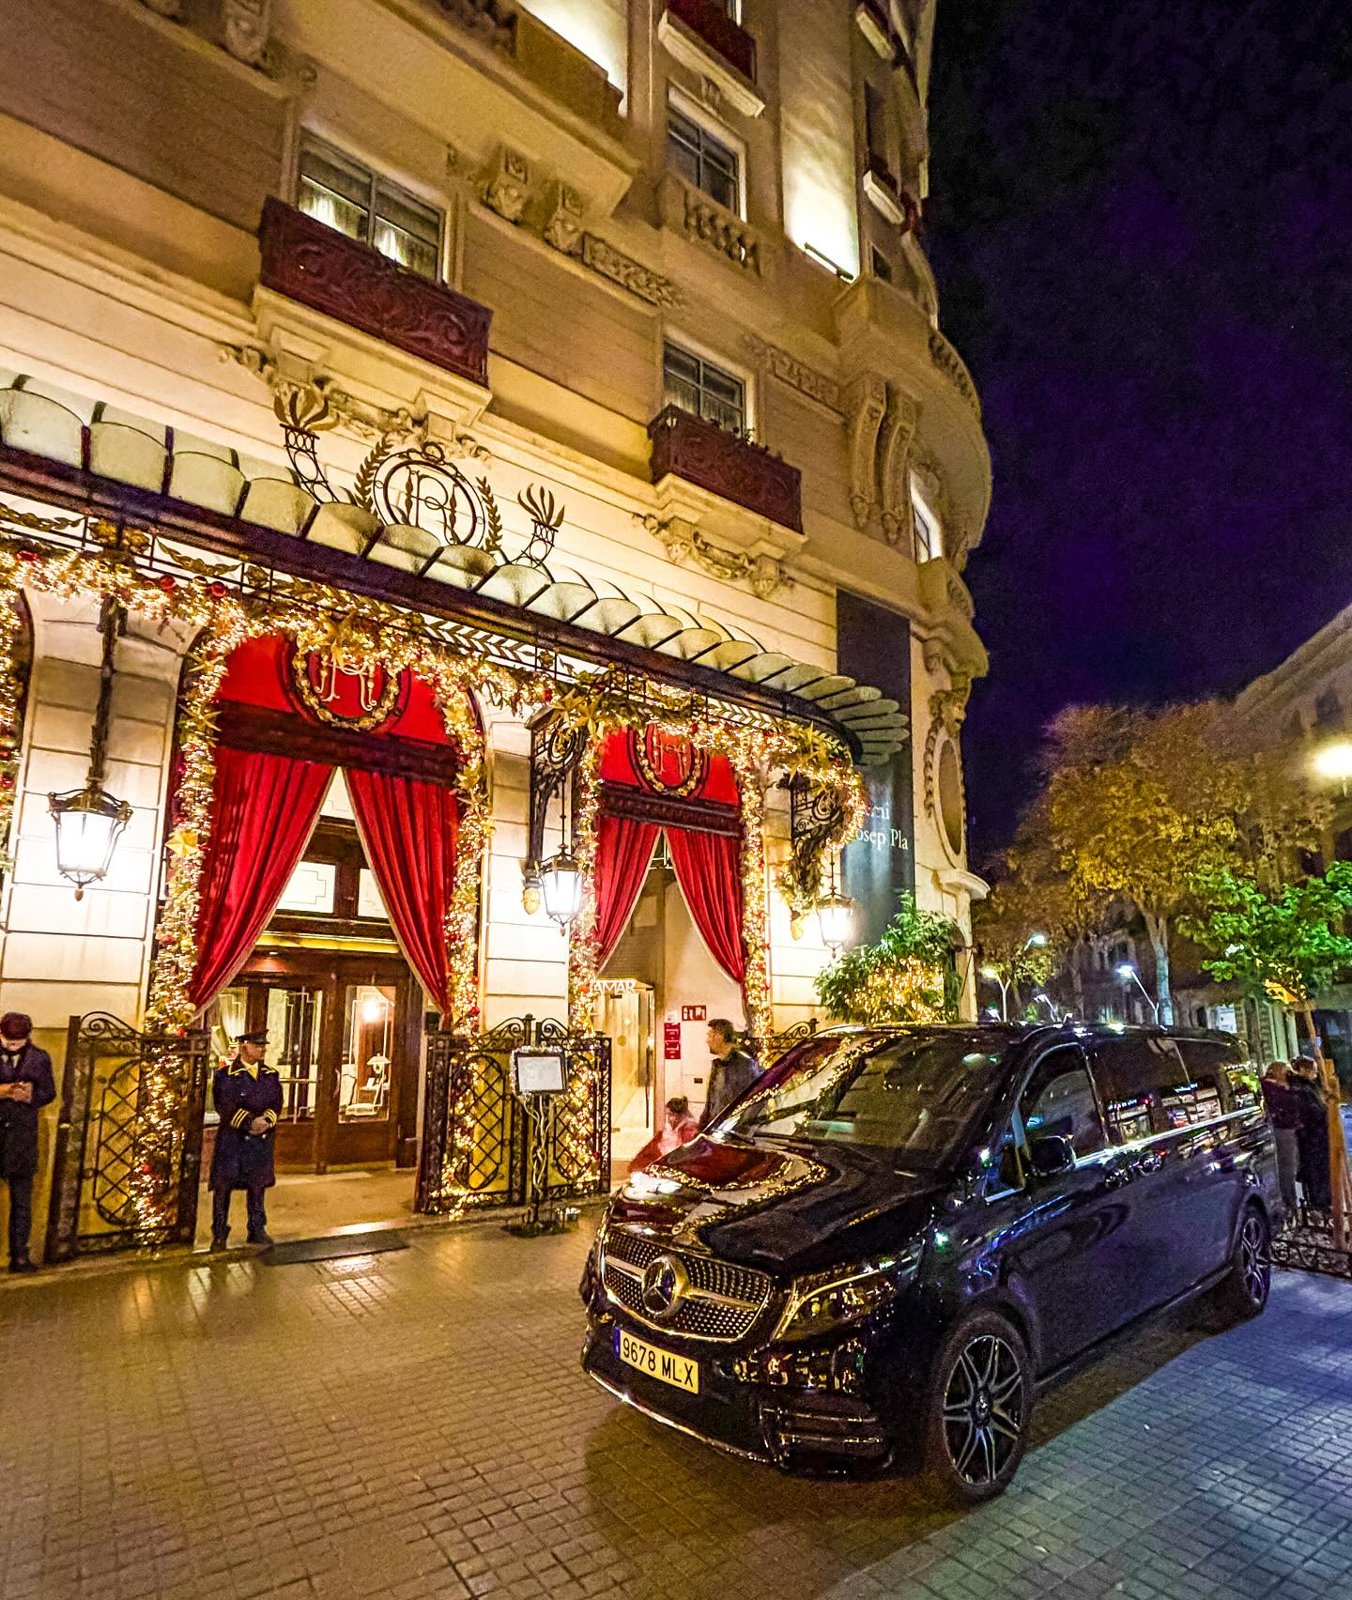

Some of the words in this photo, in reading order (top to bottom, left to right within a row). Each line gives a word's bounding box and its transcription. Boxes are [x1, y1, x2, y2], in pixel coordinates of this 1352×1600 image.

[856, 829, 886, 851] osep
[890, 829, 908, 850] Pla
[623, 1337, 656, 1372] 9678
[662, 1354, 694, 1388] MLX
